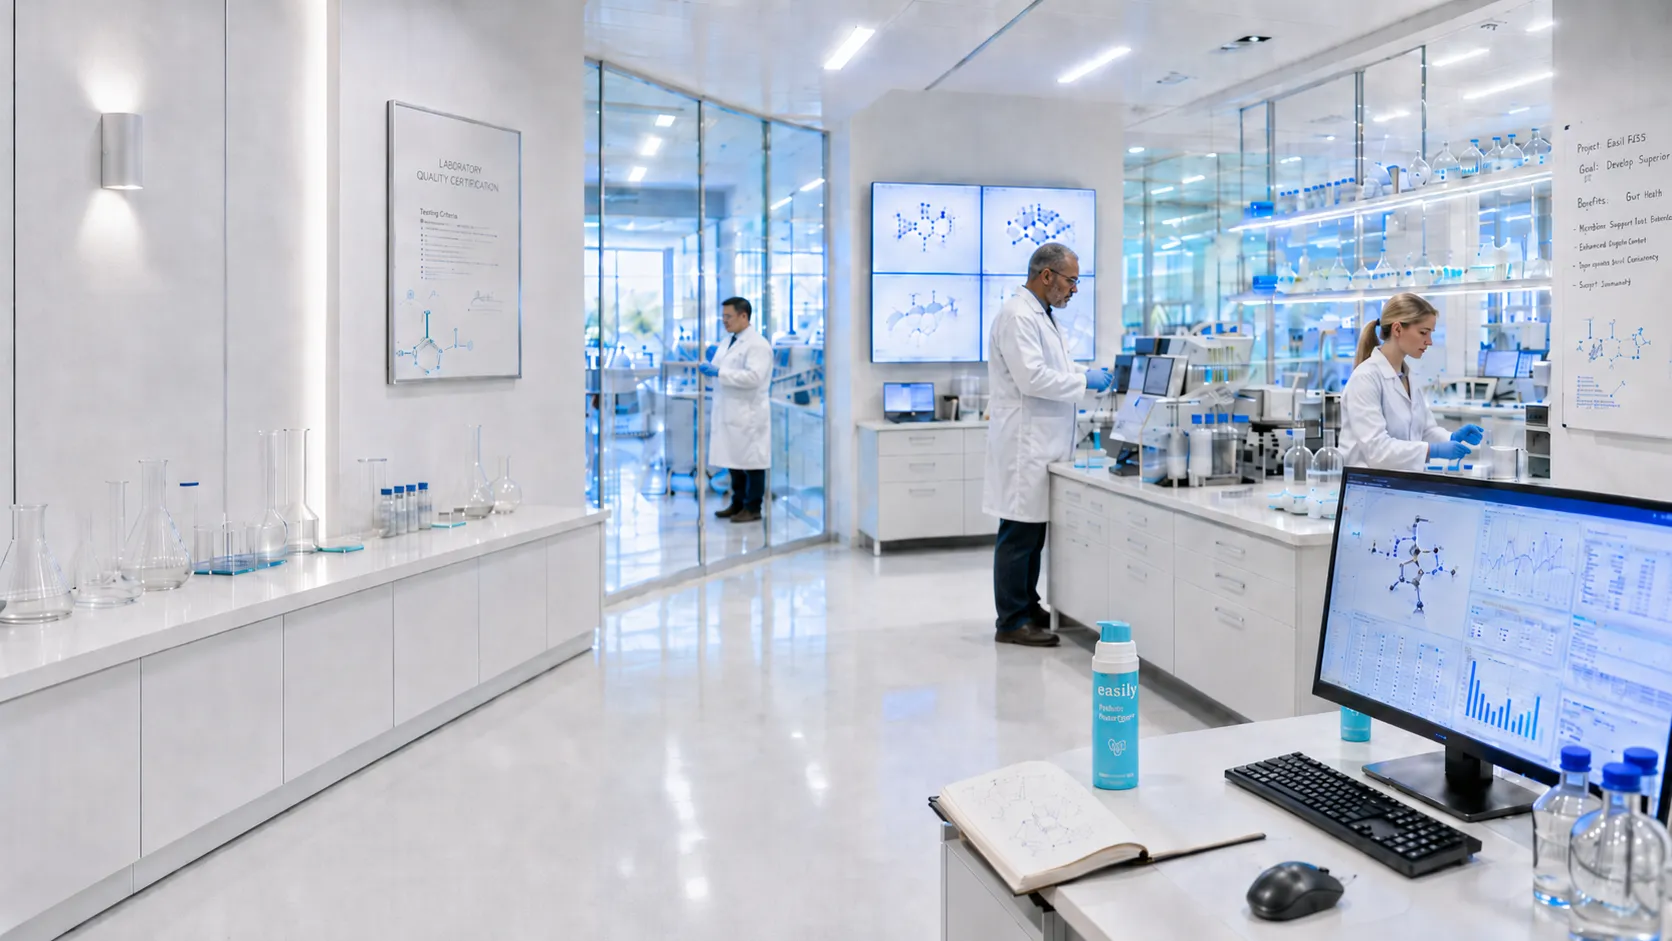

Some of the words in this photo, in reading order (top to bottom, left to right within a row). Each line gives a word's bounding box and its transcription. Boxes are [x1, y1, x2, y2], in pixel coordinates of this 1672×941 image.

[438, 158, 482, 174] LABORATORY
[1579, 161, 1599, 174] Goal:
[1606, 158, 1634, 170] Develop
[1638, 152, 1671, 167] Superior
[416, 169, 449, 184] QUALITY
[450, 175, 500, 192] CERTIFICATION
[1097, 682, 1137, 700] easily
